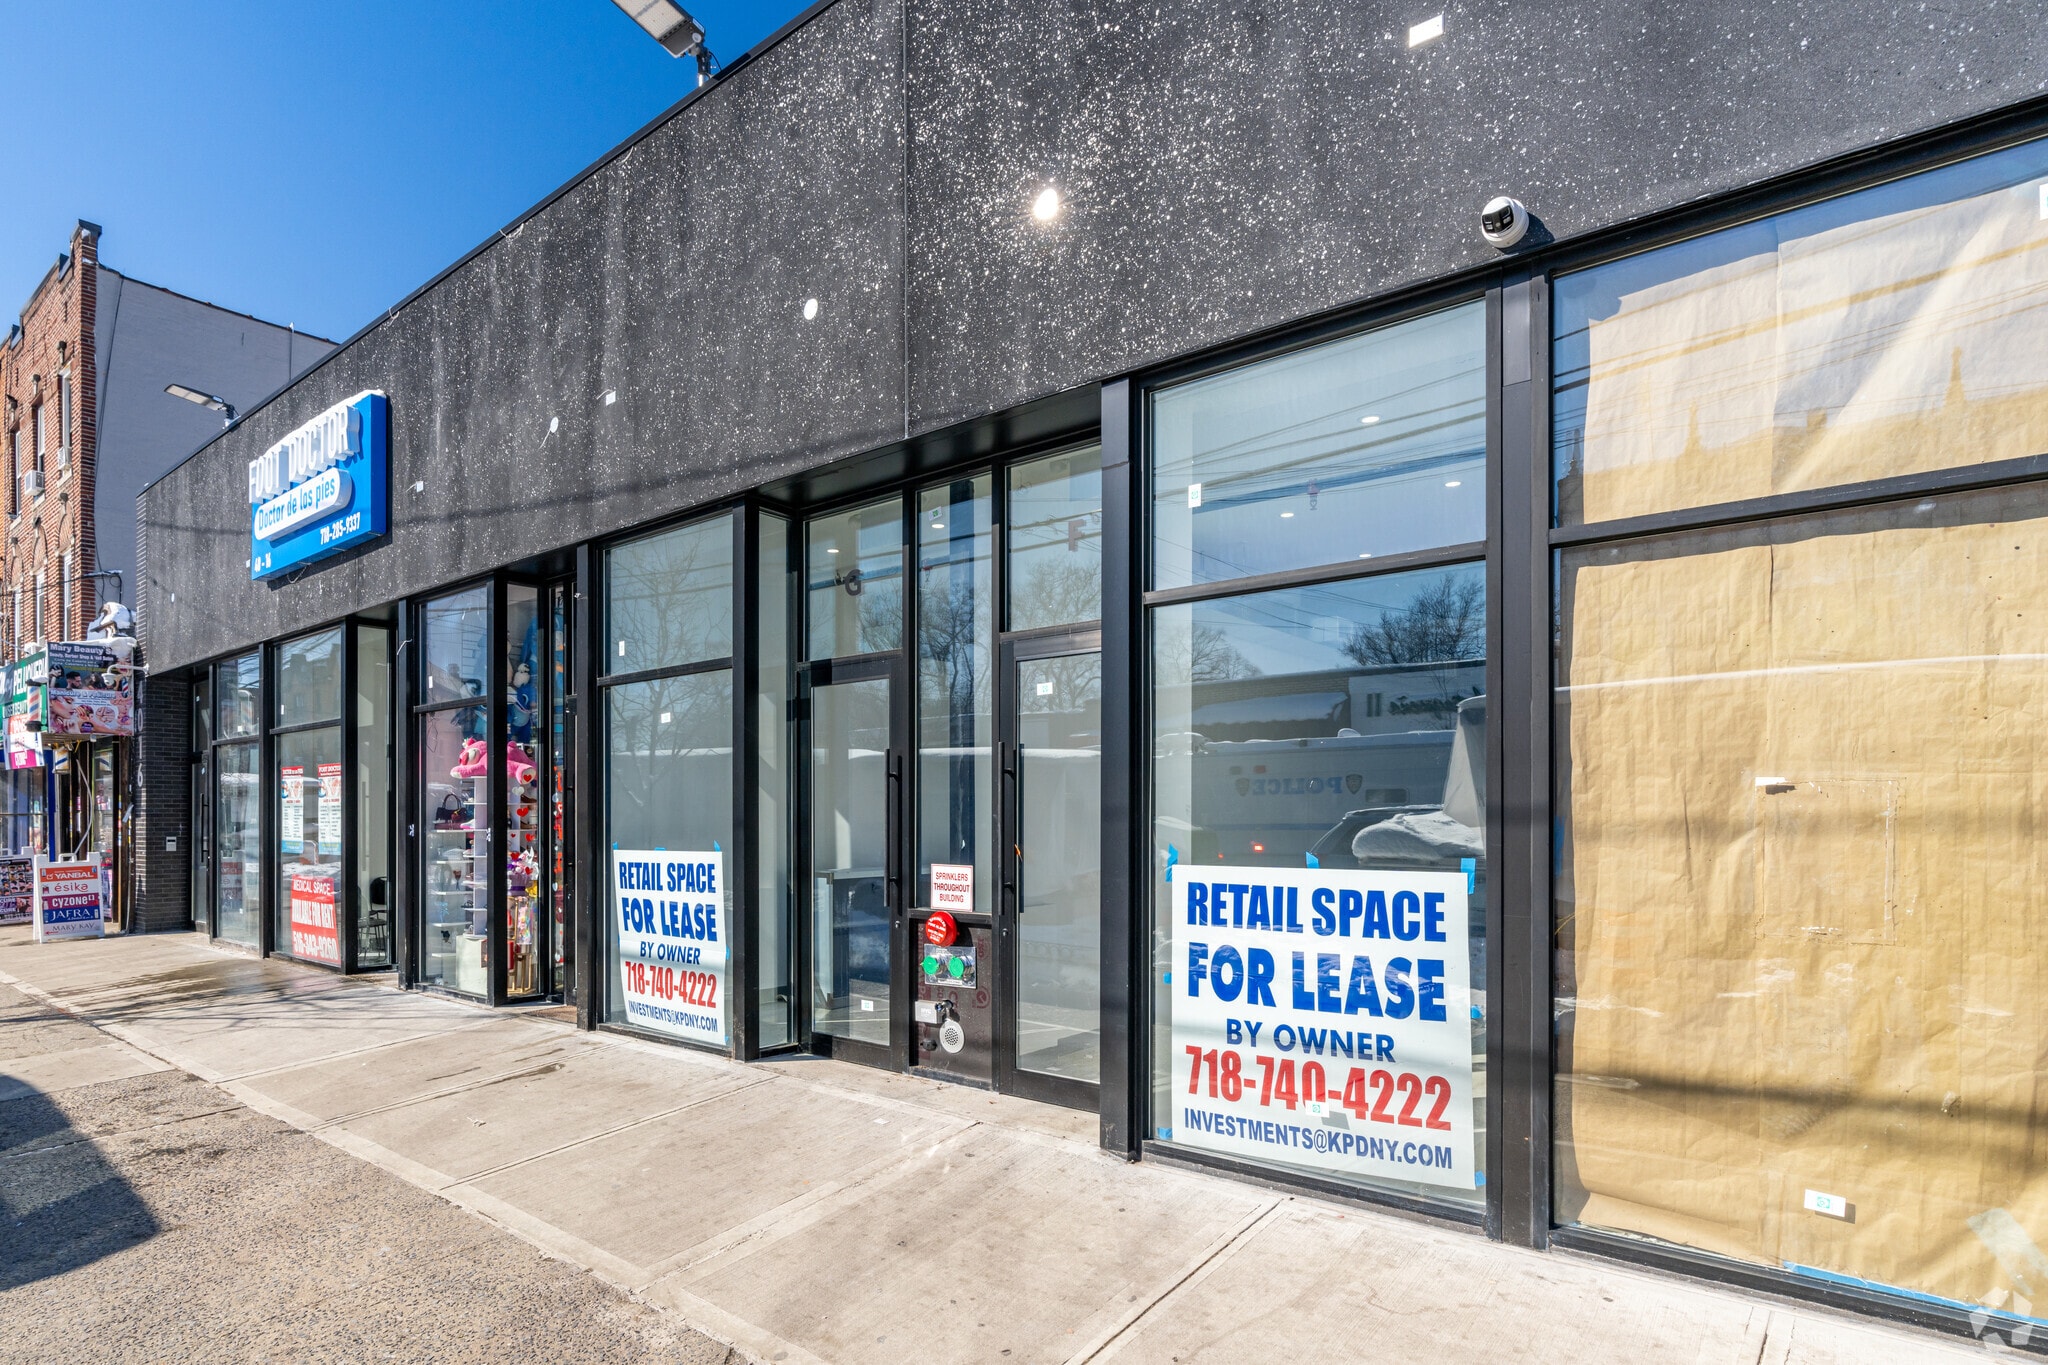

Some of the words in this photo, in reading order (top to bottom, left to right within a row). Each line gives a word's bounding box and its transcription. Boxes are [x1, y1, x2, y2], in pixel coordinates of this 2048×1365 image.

[249, 445, 285, 503] FOOT
[288, 406, 357, 482] DOCTOR
[258, 503, 285, 532] Doctor
[287, 493, 297, 516] de
[299, 489, 313, 511] los
[315, 477, 336, 509] pies
[1068, 519, 1087, 552] F
[50, 643, 72, 653] Mary
[74, 645, 104, 656] Beauty
[55, 872, 94, 880] YANBAL
[55, 882, 89, 892] ésika
[293, 879, 313, 893] MEDICAL
[313, 881, 332, 896] SPACE
[619, 861, 664, 892] RETAIL
[667, 862, 717, 894] SPACE
[934, 882, 970, 893] THROUGHOUT
[935, 872, 969, 881] SPRINKLERS
[51, 908, 91, 920] JAFRA
[939, 893, 964, 903] BUILDING
[1187, 881, 1304, 934] RETAIL
[1311, 887, 1447, 943] SPACE
[79, 922, 95, 930] KAY
[621, 897, 657, 935] FOR
[659, 900, 718, 942] LEASE
[640, 941, 655, 959] BY
[657, 943, 700, 965] OWNER
[625, 961, 717, 1009] 718-740-4222
[1187, 941, 1277, 1008] FOR
[1291, 951, 1448, 1023] LEASE
[628, 999, 719, 1033] INVESTMENTS@KPDNY.COM
[1226, 1018, 1263, 1048] BY
[1273, 1024, 1396, 1063] OWNER
[1185, 1045, 1452, 1132] 718-740-4222
[1184, 1107, 1453, 1170] INVESTMENTS@KPDNY.COM
